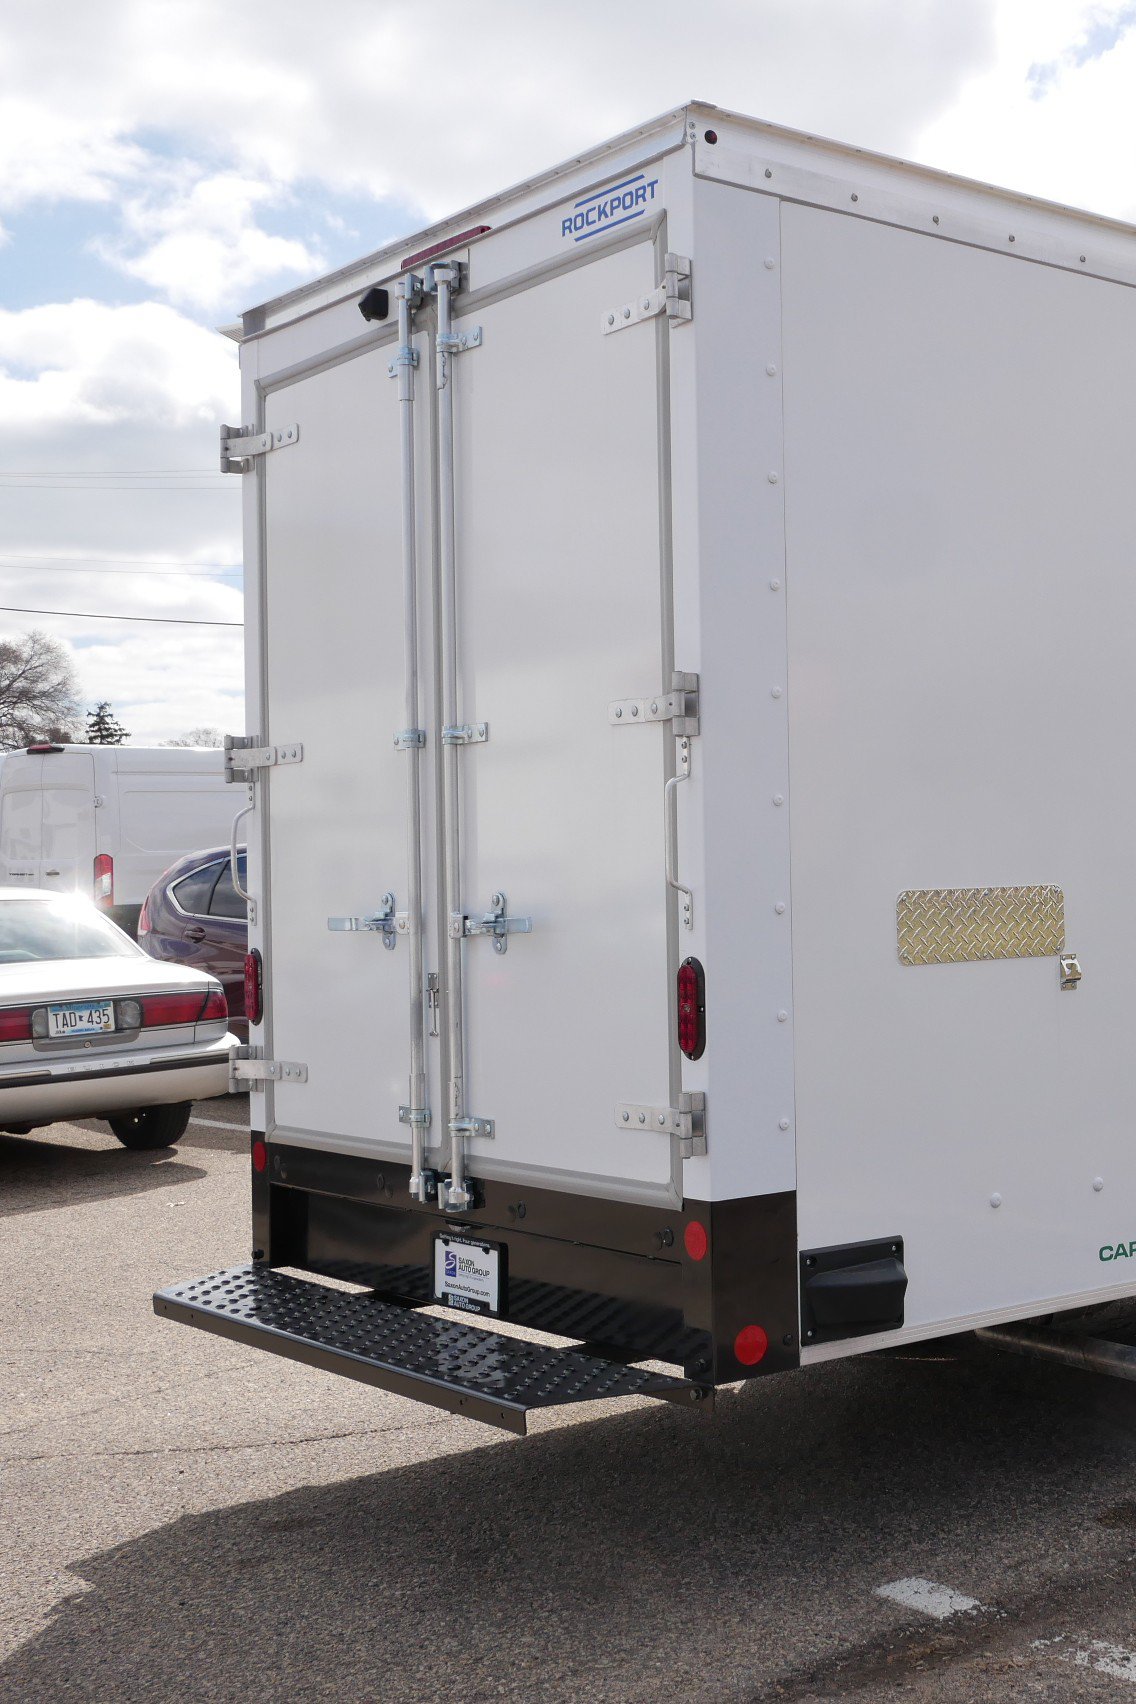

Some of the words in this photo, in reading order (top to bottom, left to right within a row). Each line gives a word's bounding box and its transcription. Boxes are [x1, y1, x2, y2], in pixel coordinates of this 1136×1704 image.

[561, 179, 659, 237] ROCKPORT
[53, 1011, 77, 1029] TAD
[87, 1008, 110, 1026] 435
[458, 1263, 472, 1273] AUTO
[472, 1267, 490, 1277] GROUP
[444, 1281, 491, 1298] SaxonAutoGroup.com
